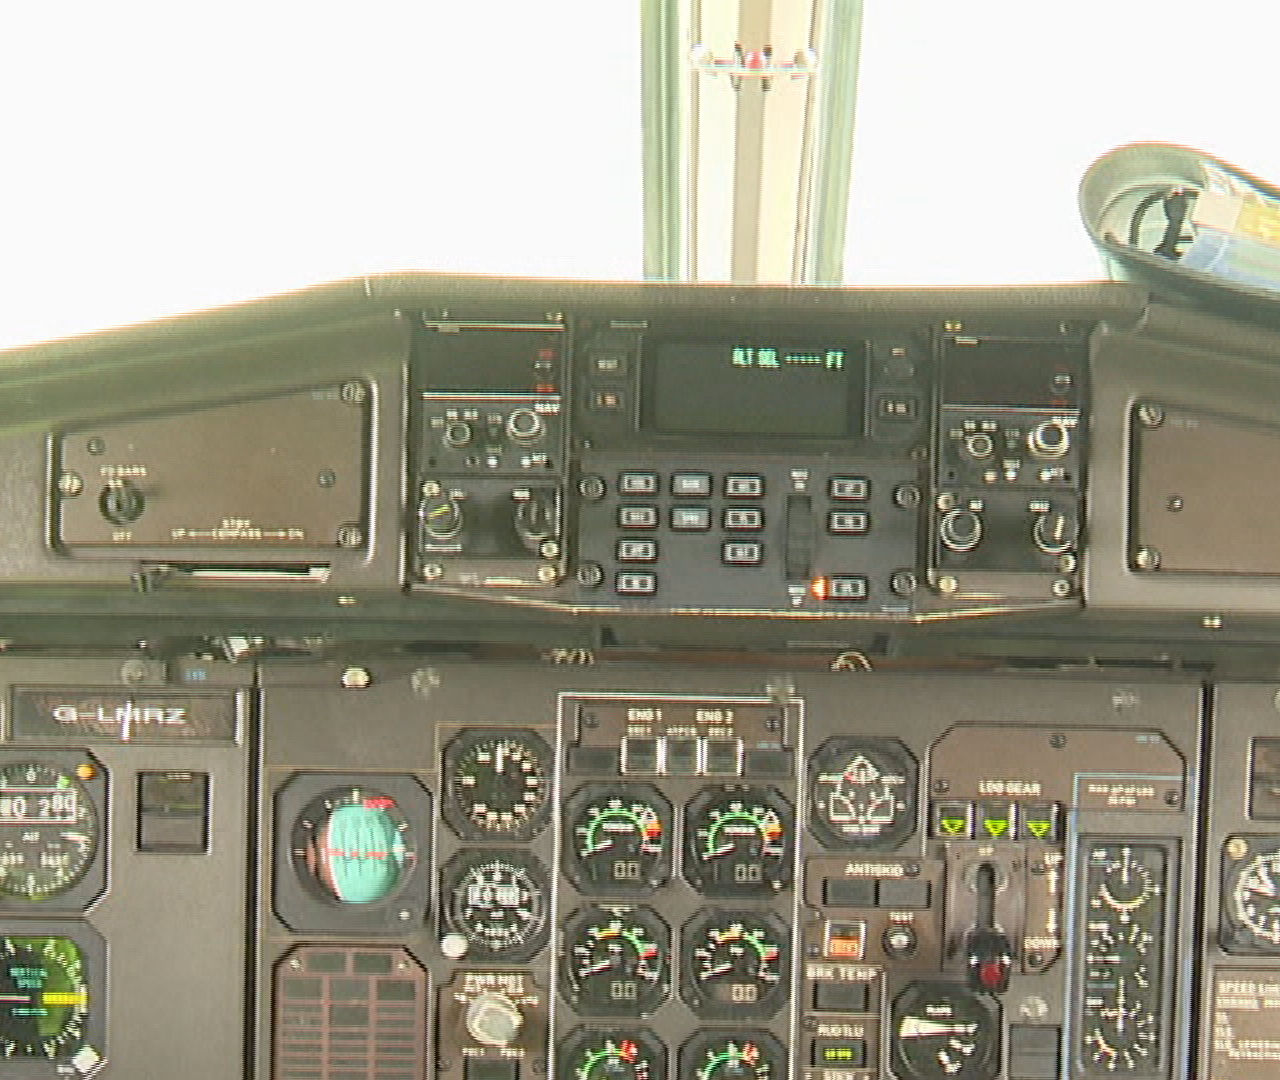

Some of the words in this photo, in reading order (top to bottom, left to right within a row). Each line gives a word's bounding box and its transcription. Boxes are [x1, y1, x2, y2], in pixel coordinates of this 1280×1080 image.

[52, 704, 186, 724] G-LMRZ
[628, 708, 651, 722] ENG
[696, 709, 722, 723] ENG
[725, 711, 733, 723] 2
[1006, 782, 1041, 797] GEAR
[840, 968, 876, 981] TEMP
